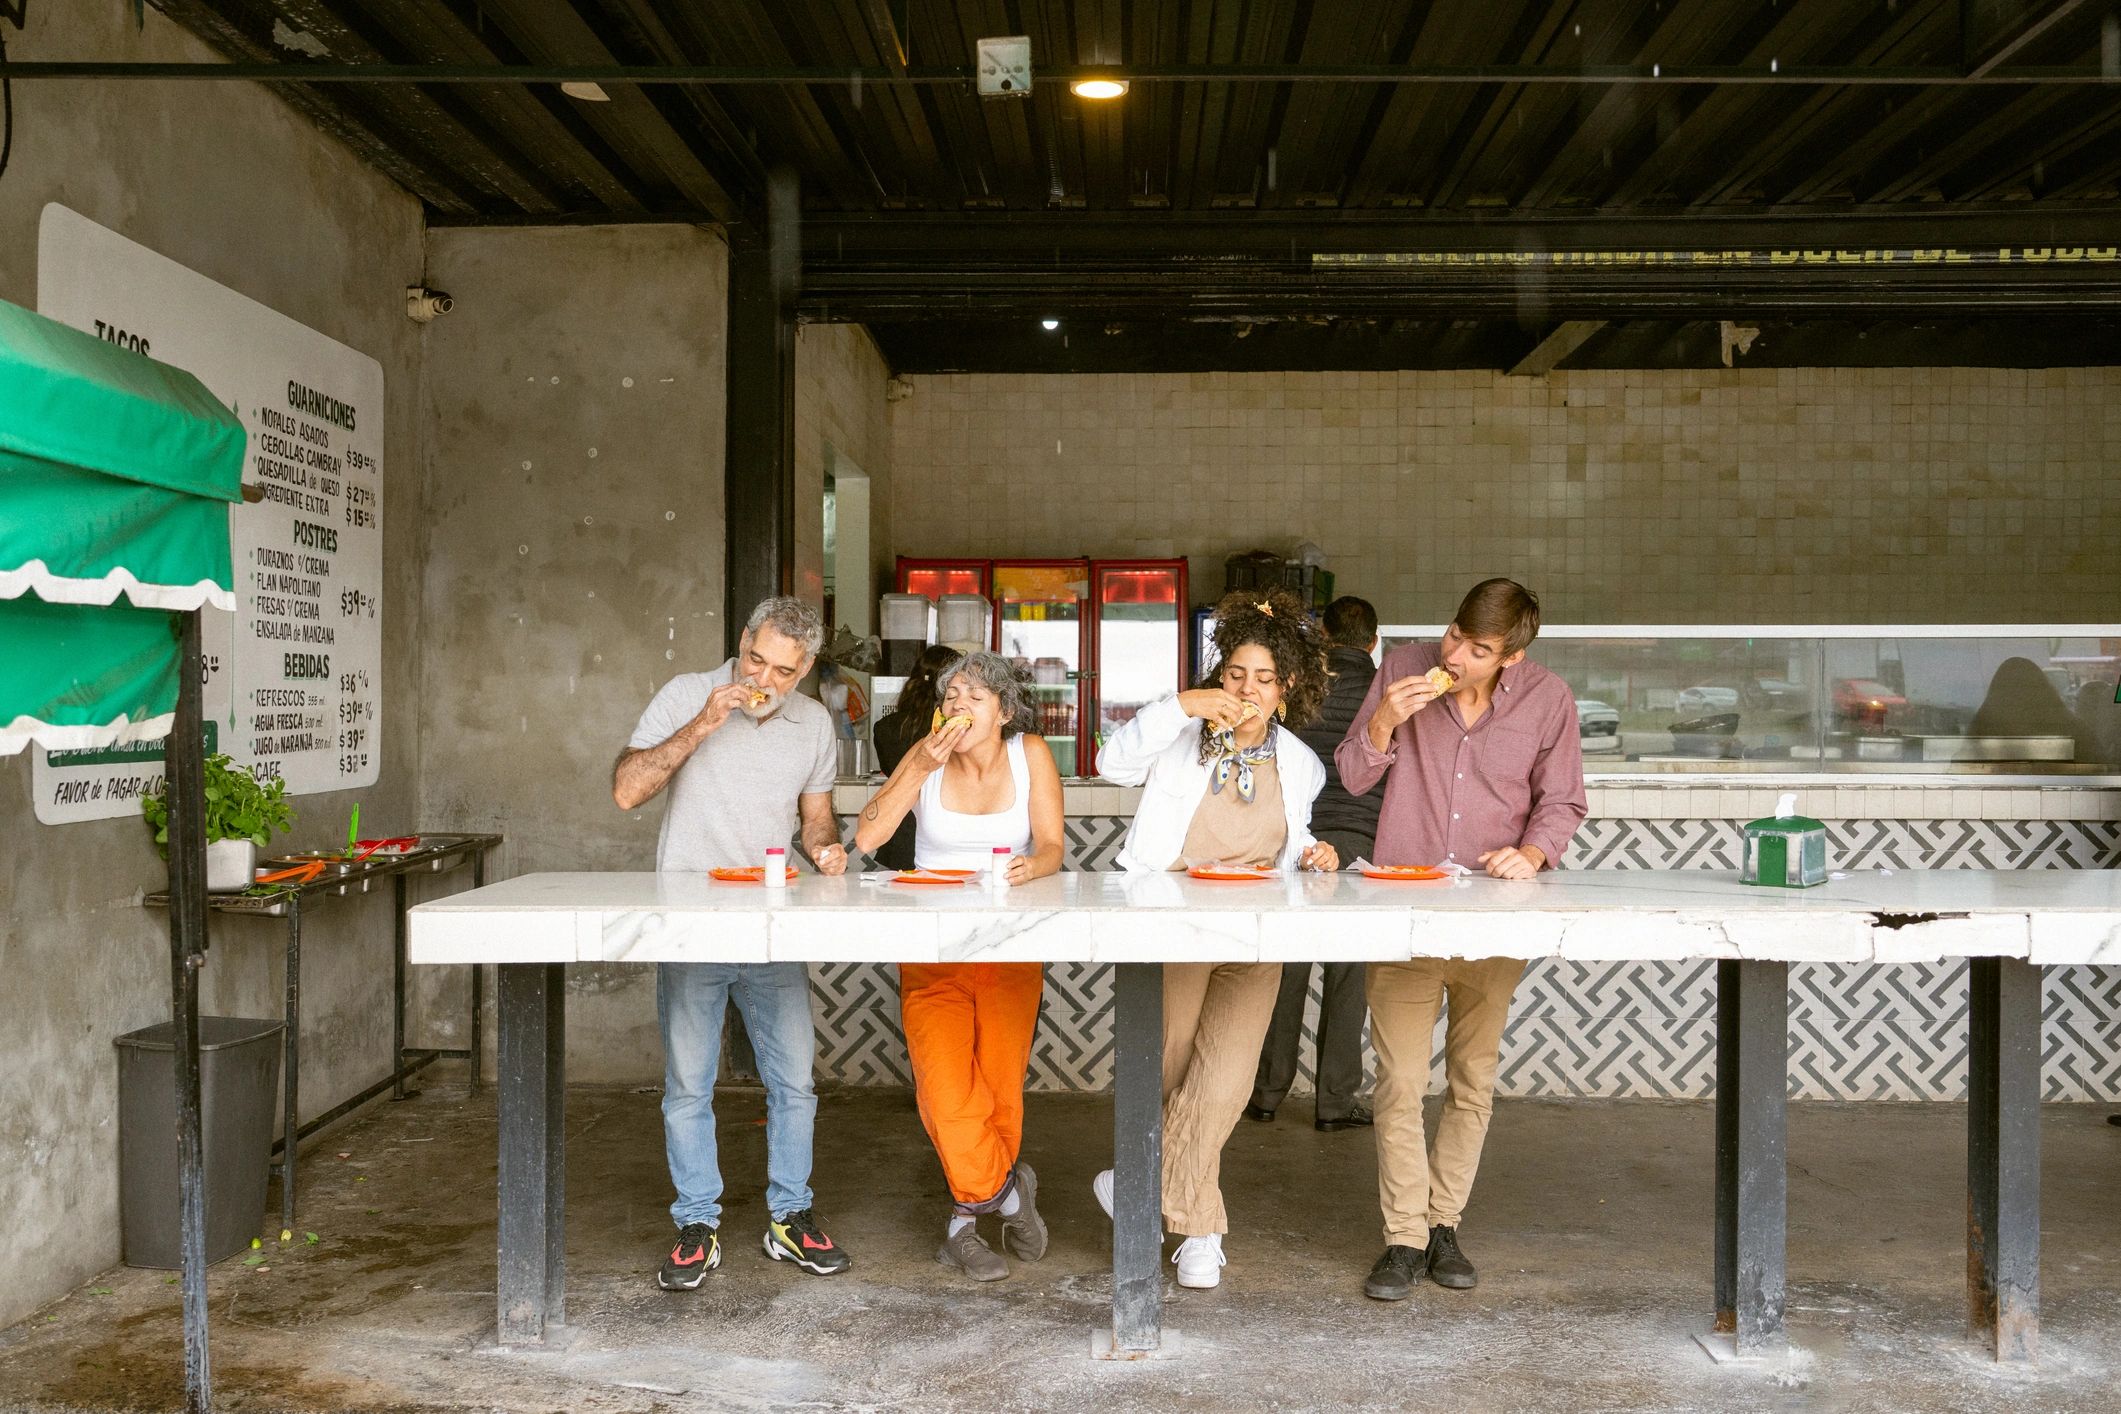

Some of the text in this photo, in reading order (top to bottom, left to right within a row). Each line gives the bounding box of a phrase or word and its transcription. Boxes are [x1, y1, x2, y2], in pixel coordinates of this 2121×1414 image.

[288, 380, 356, 431] GUARNICIONES
[262, 407, 329, 448] NOPALES ASADOS
[261, 433, 341, 476] CEBOLLAS CAMBRAY
[258, 456, 340, 497] QUESADILLA de QUESO
[306, 494, 329, 516] EXTRA
[294, 519, 338, 554] POSTRES
[257, 547, 294, 572] DURAZNOS
[257, 572, 321, 598] FLAN NAPOLITANO
[256, 595, 286, 616] FRESAS
[256, 619, 335, 646] ENSALADA de MANZANA
[284, 652, 330, 679] BEBIDAS
[256, 689, 305, 707] REFRESCOS
[255, 714, 275, 732] AGUA
[277, 712, 303, 730] FRESCA
[254, 736, 273, 756] JUGO
[281, 732, 313, 754] NARANJA
[54, 780, 90, 805] FAVOR
[91, 778, 102, 800] de
[106, 777, 141, 802] PAGAR
